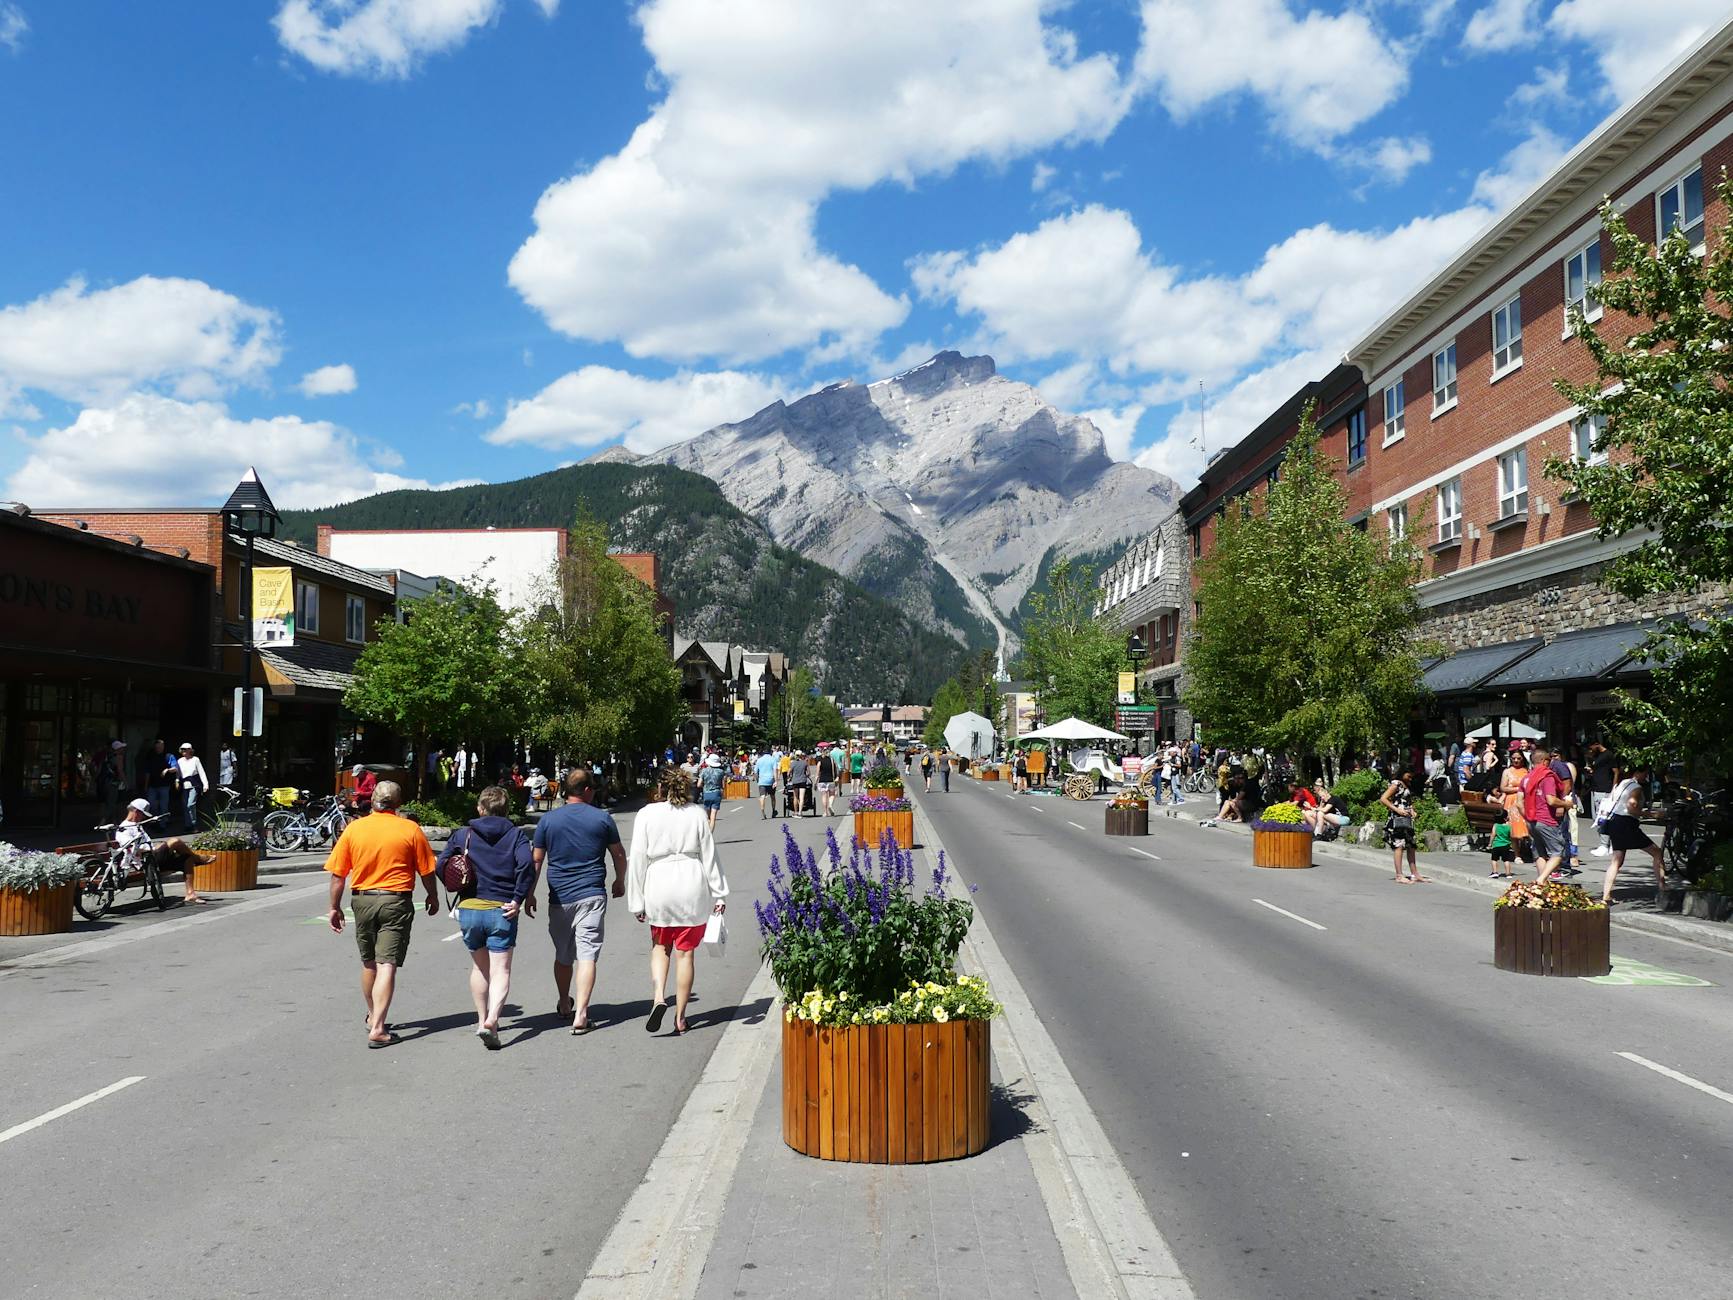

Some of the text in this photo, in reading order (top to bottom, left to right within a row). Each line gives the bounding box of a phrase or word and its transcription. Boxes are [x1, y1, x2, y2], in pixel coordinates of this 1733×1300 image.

[259, 579, 282, 588] Cave
[259, 588, 277, 596] and
[84, 585, 143, 624] BAY
[259, 598, 285, 607] Basin
